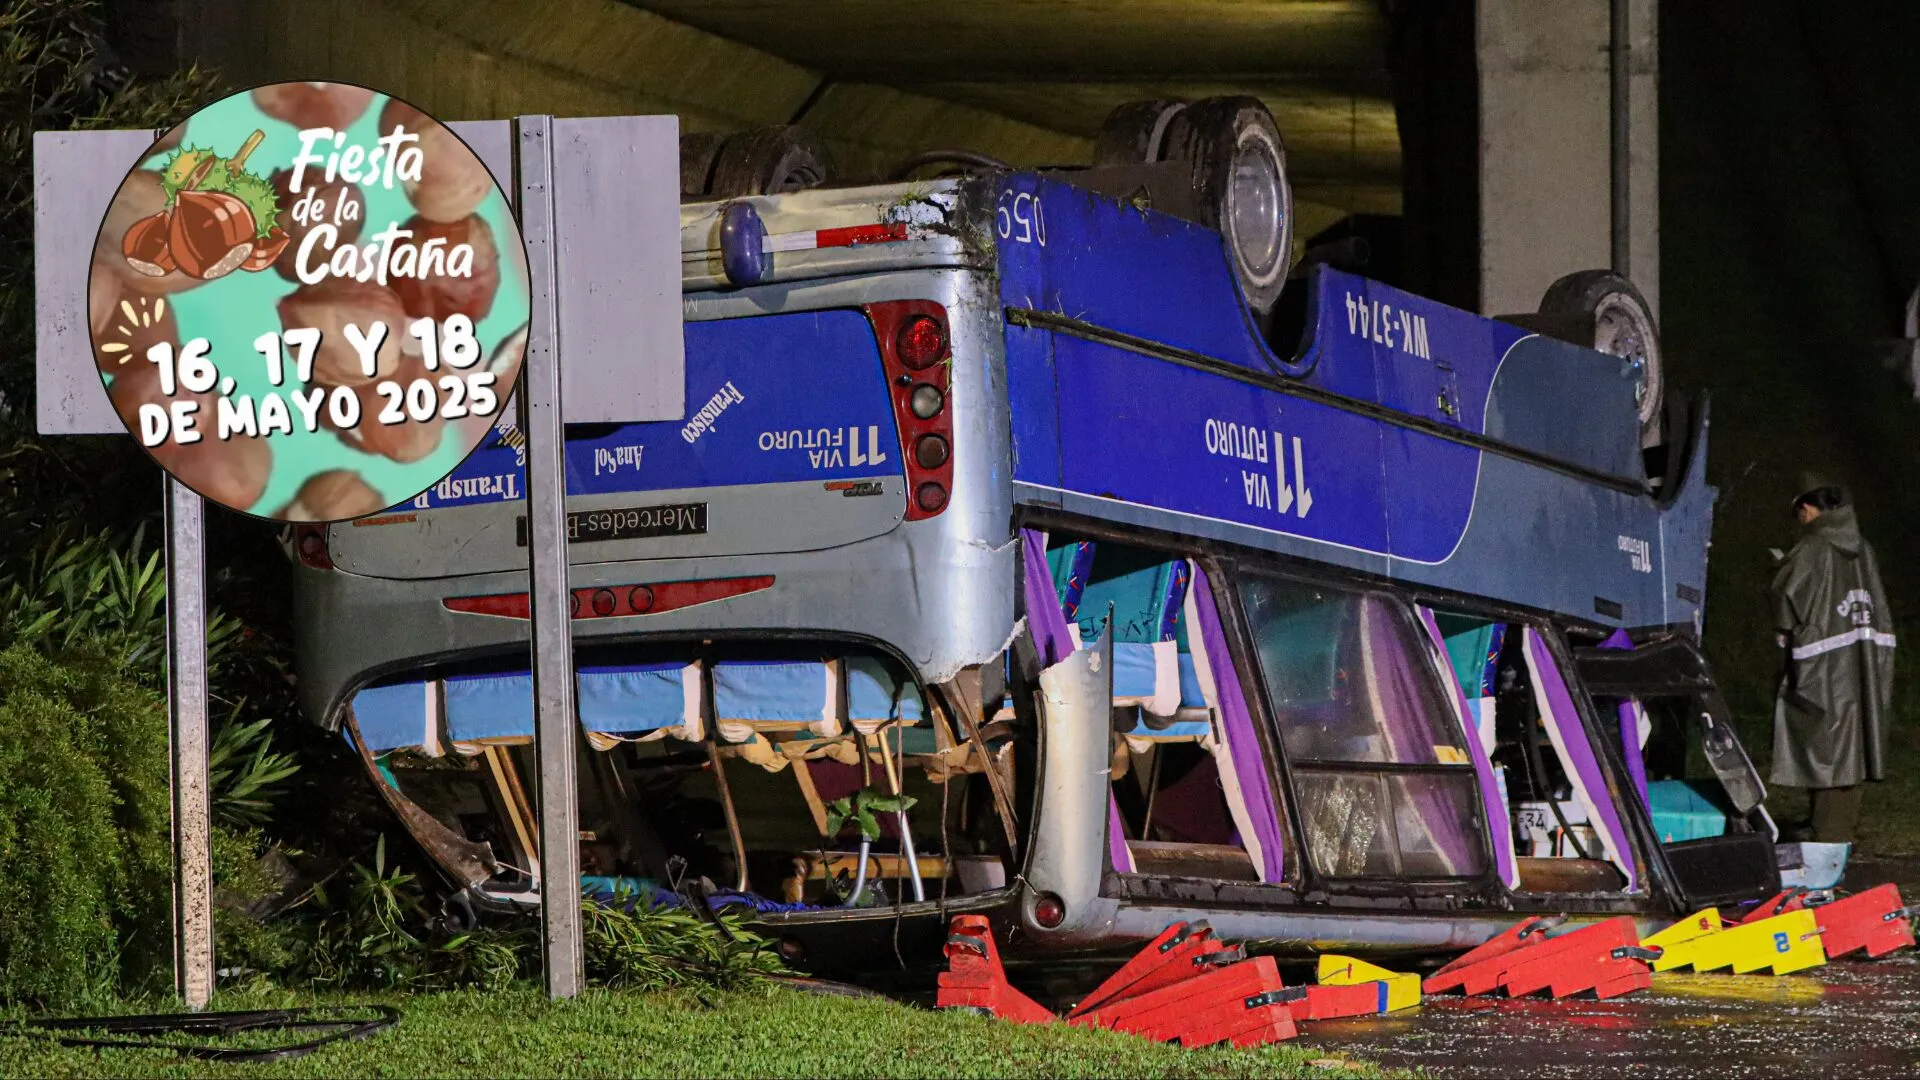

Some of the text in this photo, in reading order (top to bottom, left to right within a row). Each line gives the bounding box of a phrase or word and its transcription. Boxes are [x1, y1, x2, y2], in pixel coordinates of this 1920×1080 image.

[998, 189, 1046, 247] 059
[1345, 291, 1431, 361] WK-3744
[681, 380, 746, 445] Fransisco
[758, 427, 843, 451] FUTURO
[808, 449, 844, 469] VIA
[849, 425, 887, 468] 11
[1204, 418, 1269, 464] FUTURO
[594, 445, 645, 476] AnaSol
[1273, 431, 1314, 519] 11
[431, 473, 520, 500] Transp.
[1241, 470, 1272, 510] VIA
[567, 506, 699, 539] Mercedes-B
